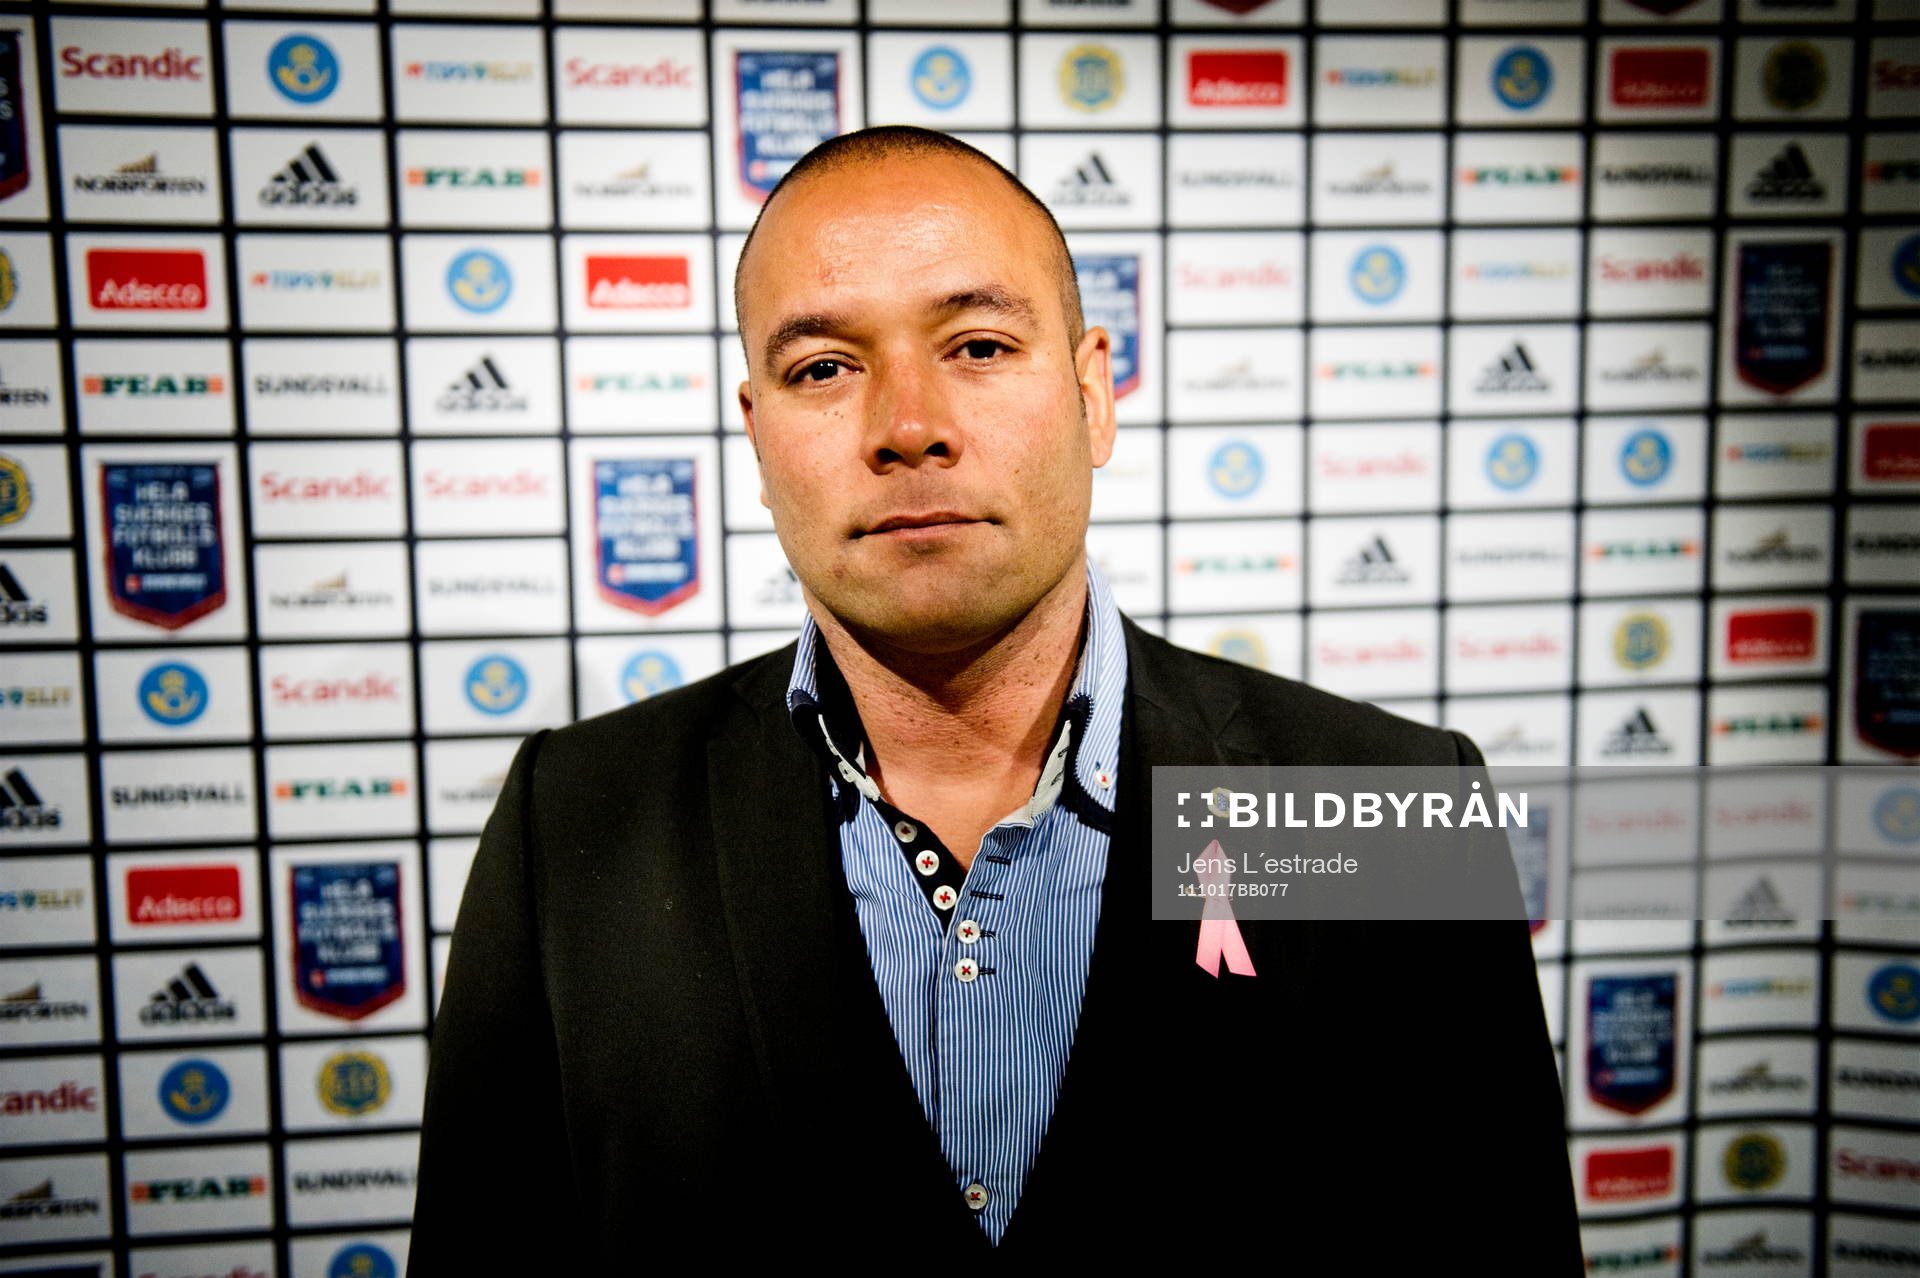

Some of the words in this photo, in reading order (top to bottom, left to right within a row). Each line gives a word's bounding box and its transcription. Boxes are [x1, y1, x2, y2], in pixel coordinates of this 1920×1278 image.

[60, 46, 203, 80] Scandic
[565, 57, 692, 88] Scandic
[424, 168, 526, 188] PEAB
[99, 278, 201, 305] Adecco
[103, 374, 208, 396] PEAB
[254, 375, 389, 395] SUNDSVALL
[260, 470, 391, 501] Scandic
[271, 672, 399, 706] Scandic
[110, 783, 246, 809] SUNDSVALL
[292, 777, 392, 800] PEAB
[138, 894, 236, 920] Adecco
[0, 1080, 97, 1116] andic
[149, 1176, 249, 1204] PEAB
